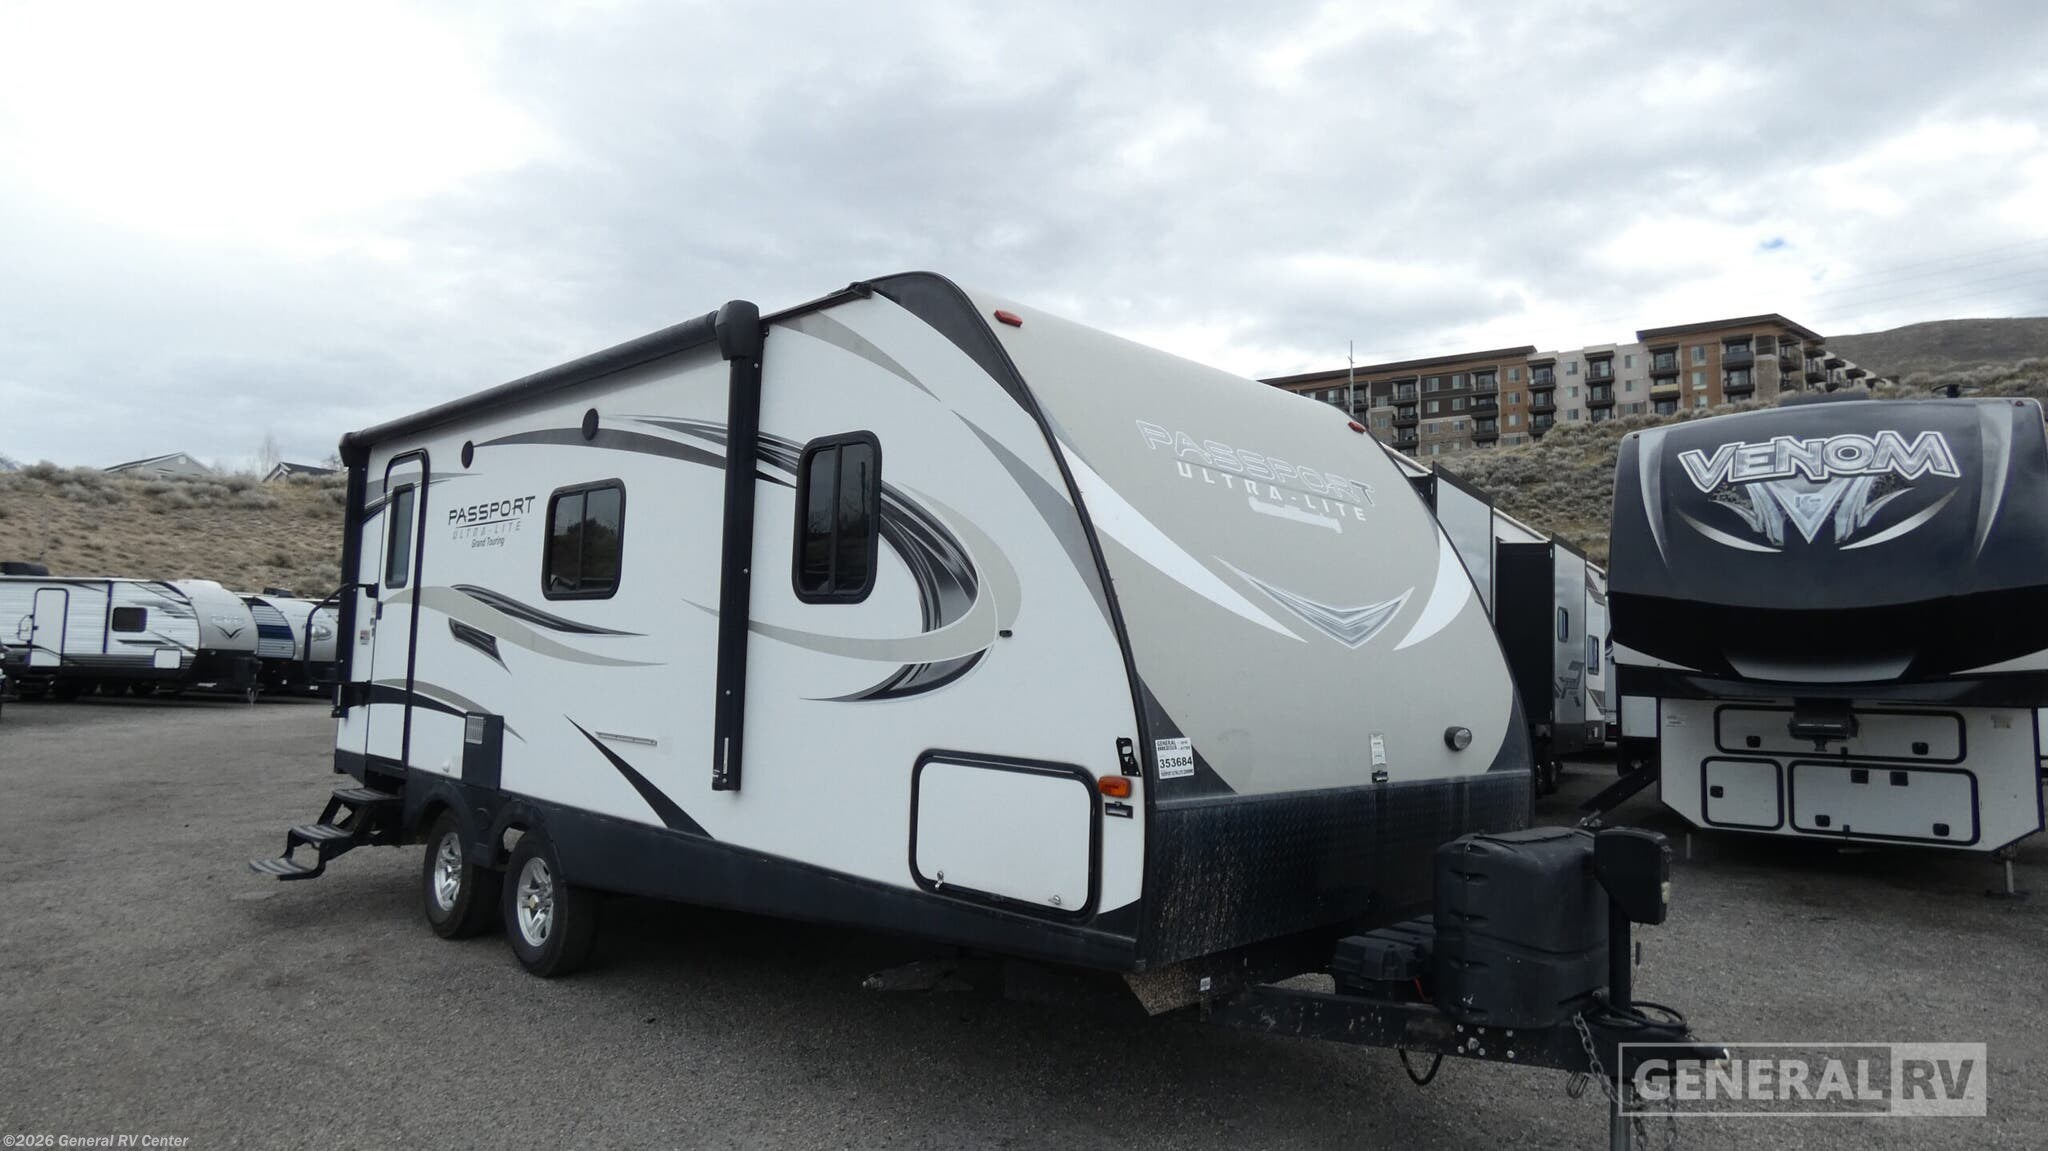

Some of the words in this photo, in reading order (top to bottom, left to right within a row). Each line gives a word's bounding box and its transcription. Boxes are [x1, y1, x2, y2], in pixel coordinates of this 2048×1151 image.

[1136, 420, 1375, 507] PASSPORT
[1677, 430, 1961, 493] VENOM
[1176, 460, 1367, 521] ULTRA-LITE
[448, 495, 536, 526] PASSPORT
[452, 520, 521, 540] ULTRA-LITE
[471, 538, 486, 548] Grand
[487, 536, 505, 547] Touring
[1159, 756, 1192, 769] 353684
